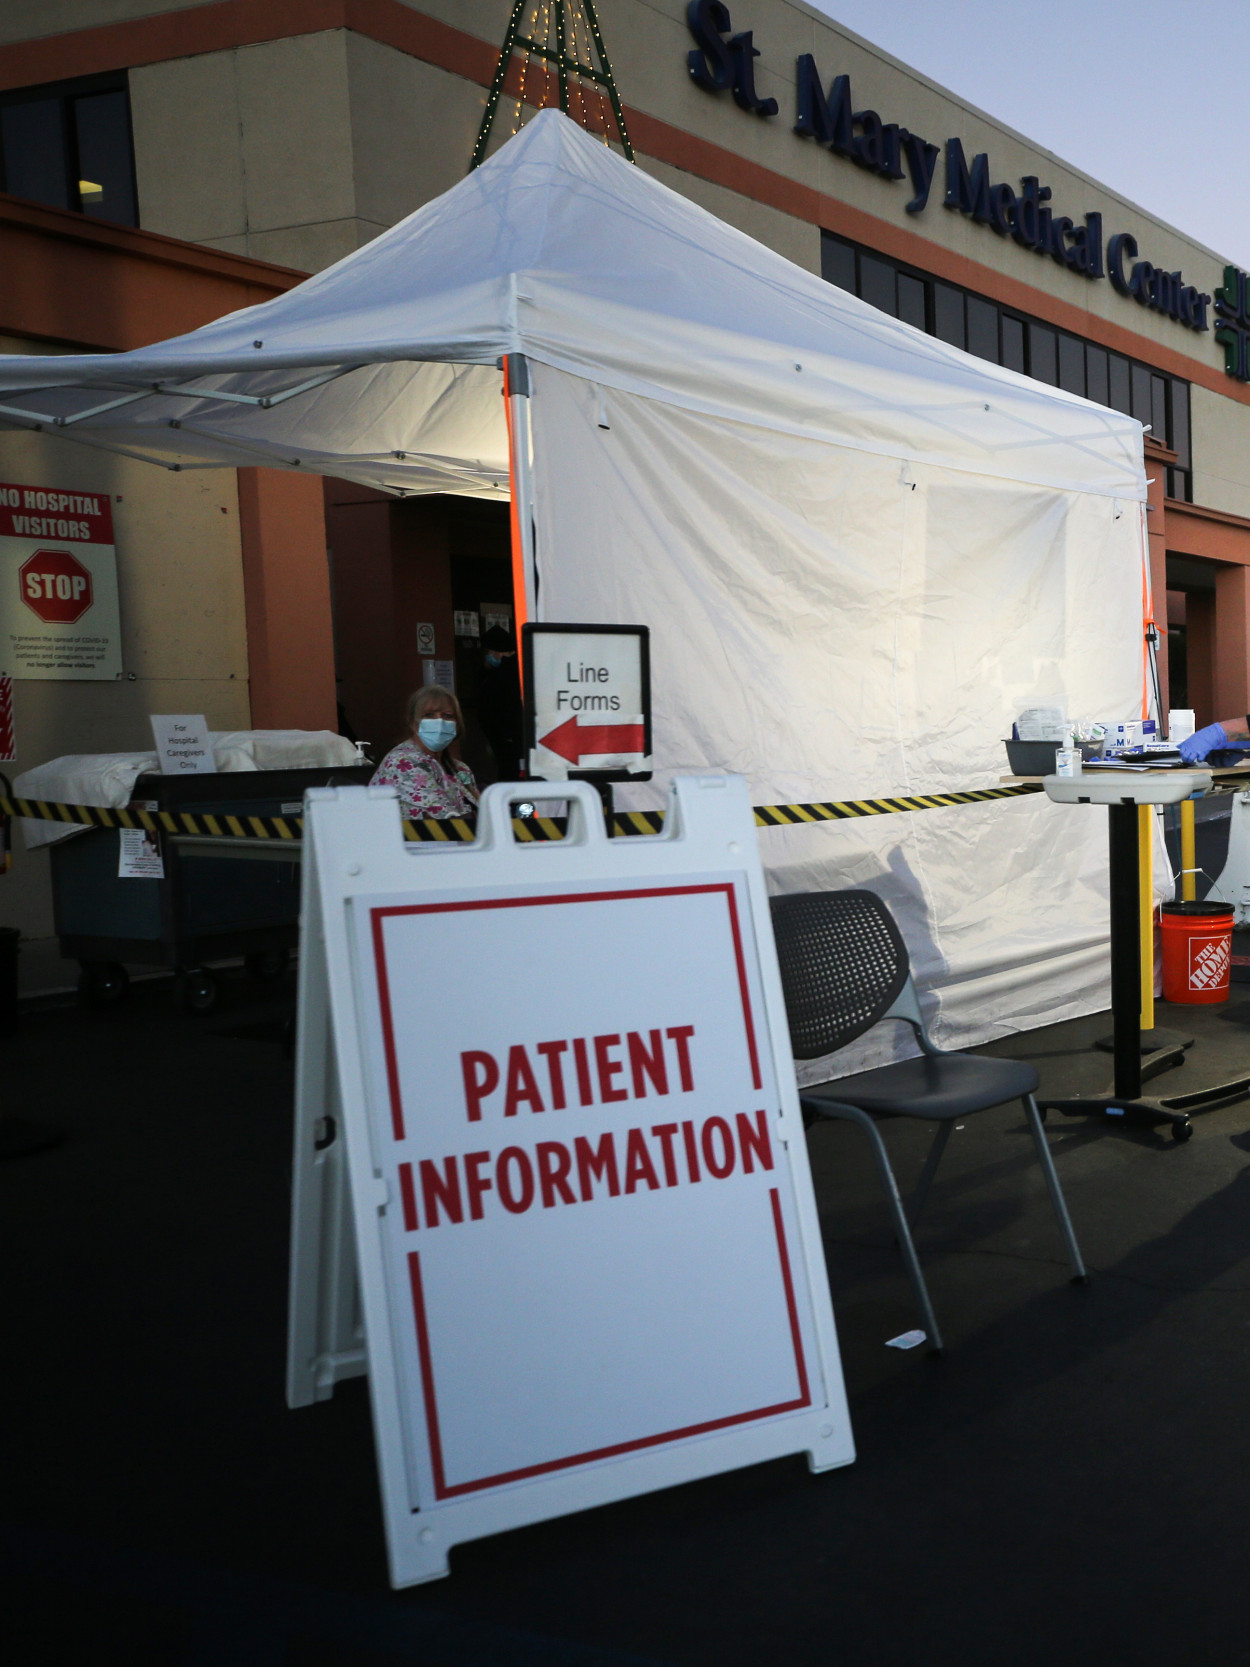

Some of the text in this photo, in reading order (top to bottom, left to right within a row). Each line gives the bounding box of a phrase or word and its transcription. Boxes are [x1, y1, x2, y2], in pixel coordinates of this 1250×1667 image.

[687, 0, 1212, 331] St. Mary Medical Center
[24, 490, 102, 515] HOSPITAL
[12, 515, 90, 539] VISITORS
[26, 572, 86, 601] STOP
[567, 662, 609, 683] Line
[557, 690, 620, 711] Forms
[168, 737, 199, 745] Hospital
[167, 749, 205, 758] Caregivers
[180, 761, 197, 769] Only
[1190, 936, 1230, 989] HOME
[1194, 943, 1215, 963] THE
[460, 1025, 695, 1122] PATIENT
[398, 1110, 775, 1232] INFORMATION
